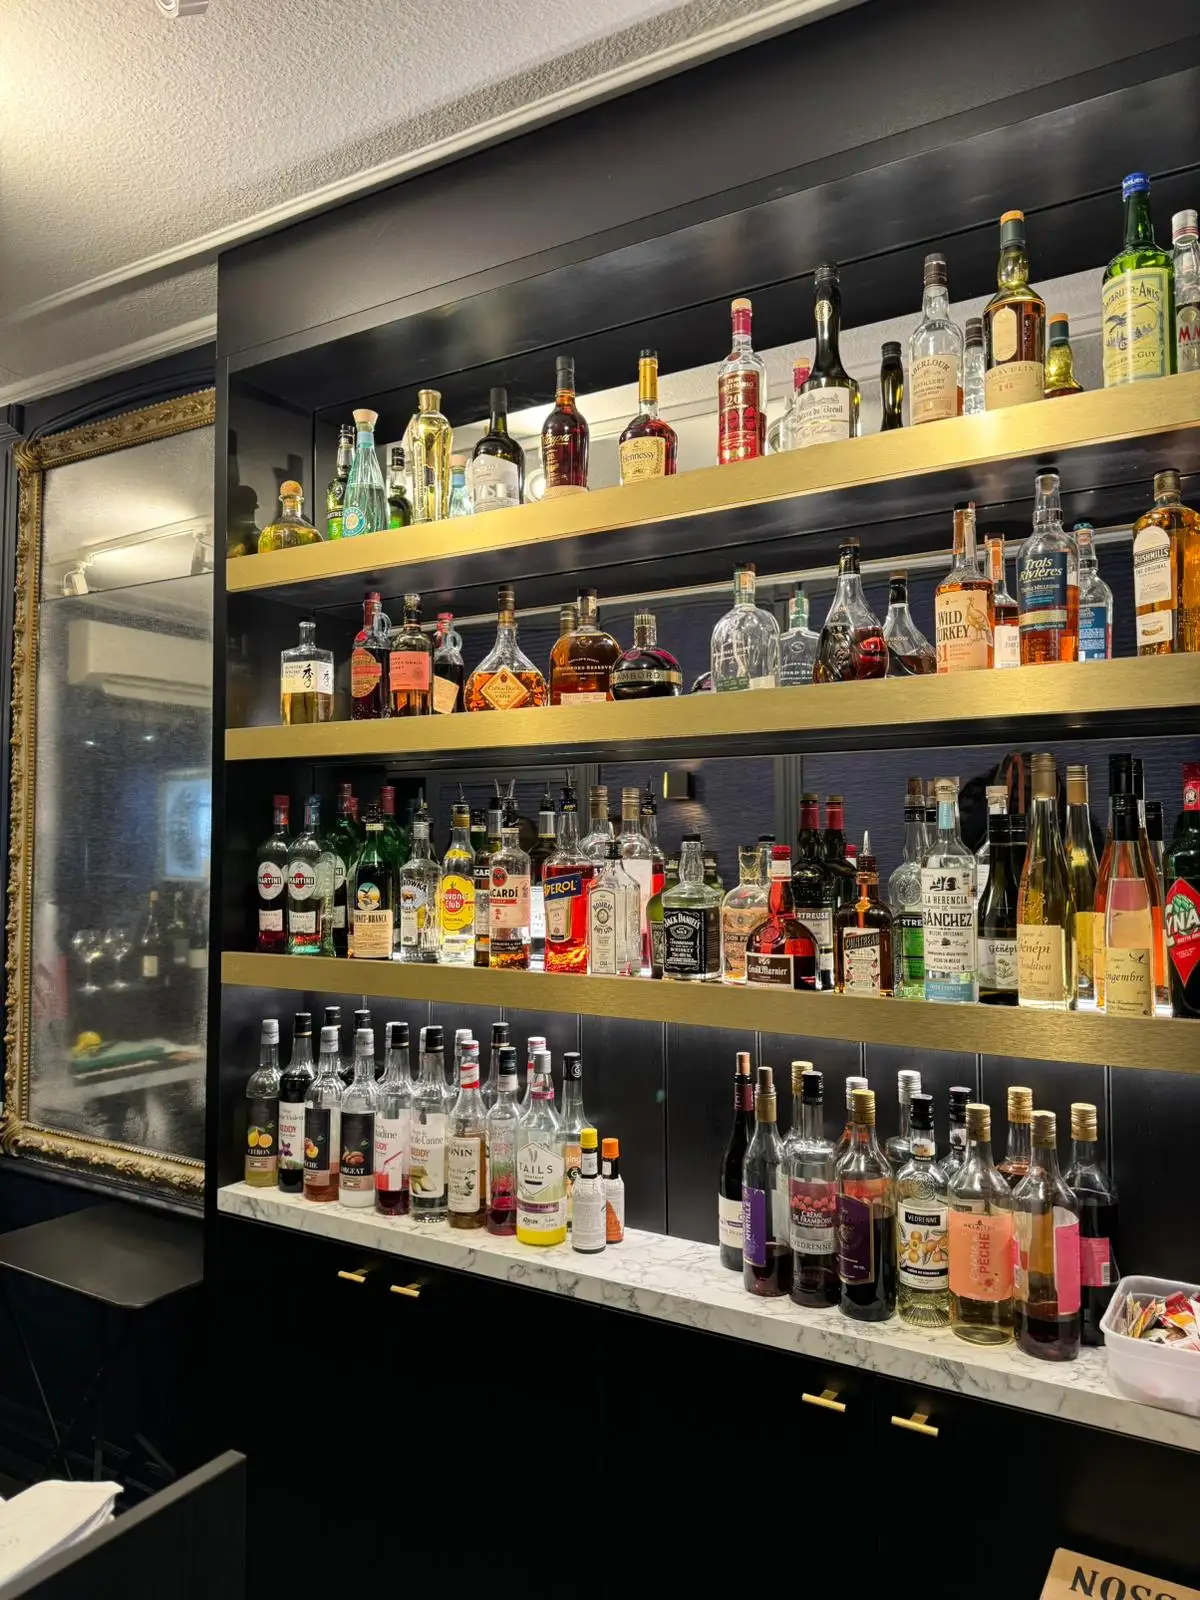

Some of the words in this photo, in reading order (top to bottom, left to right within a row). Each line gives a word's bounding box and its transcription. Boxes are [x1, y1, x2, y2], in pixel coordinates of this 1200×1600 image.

[623, 451, 654, 463] Hennessy
[1024, 557, 1053, 570] Trois
[1019, 567, 1063, 582] Rivières
[938, 611, 963, 626] WILD
[445, 900, 461, 909] Club
[923, 895, 932, 904] LA
[933, 895, 968, 905] HERENCIA
[592, 901, 614, 912] BOMBAY
[664, 916, 678, 928] JACK
[923, 908, 973, 927] SÁNCHEZ
[519, 1162, 554, 1174] TAILS
[745, 1201, 753, 1241] MYRTILLE
[907, 1213, 938, 1224] VEDRENNE
[979, 1232, 991, 1274] PÊCHE
[1069, 1566, 1178, 1600] NOS
